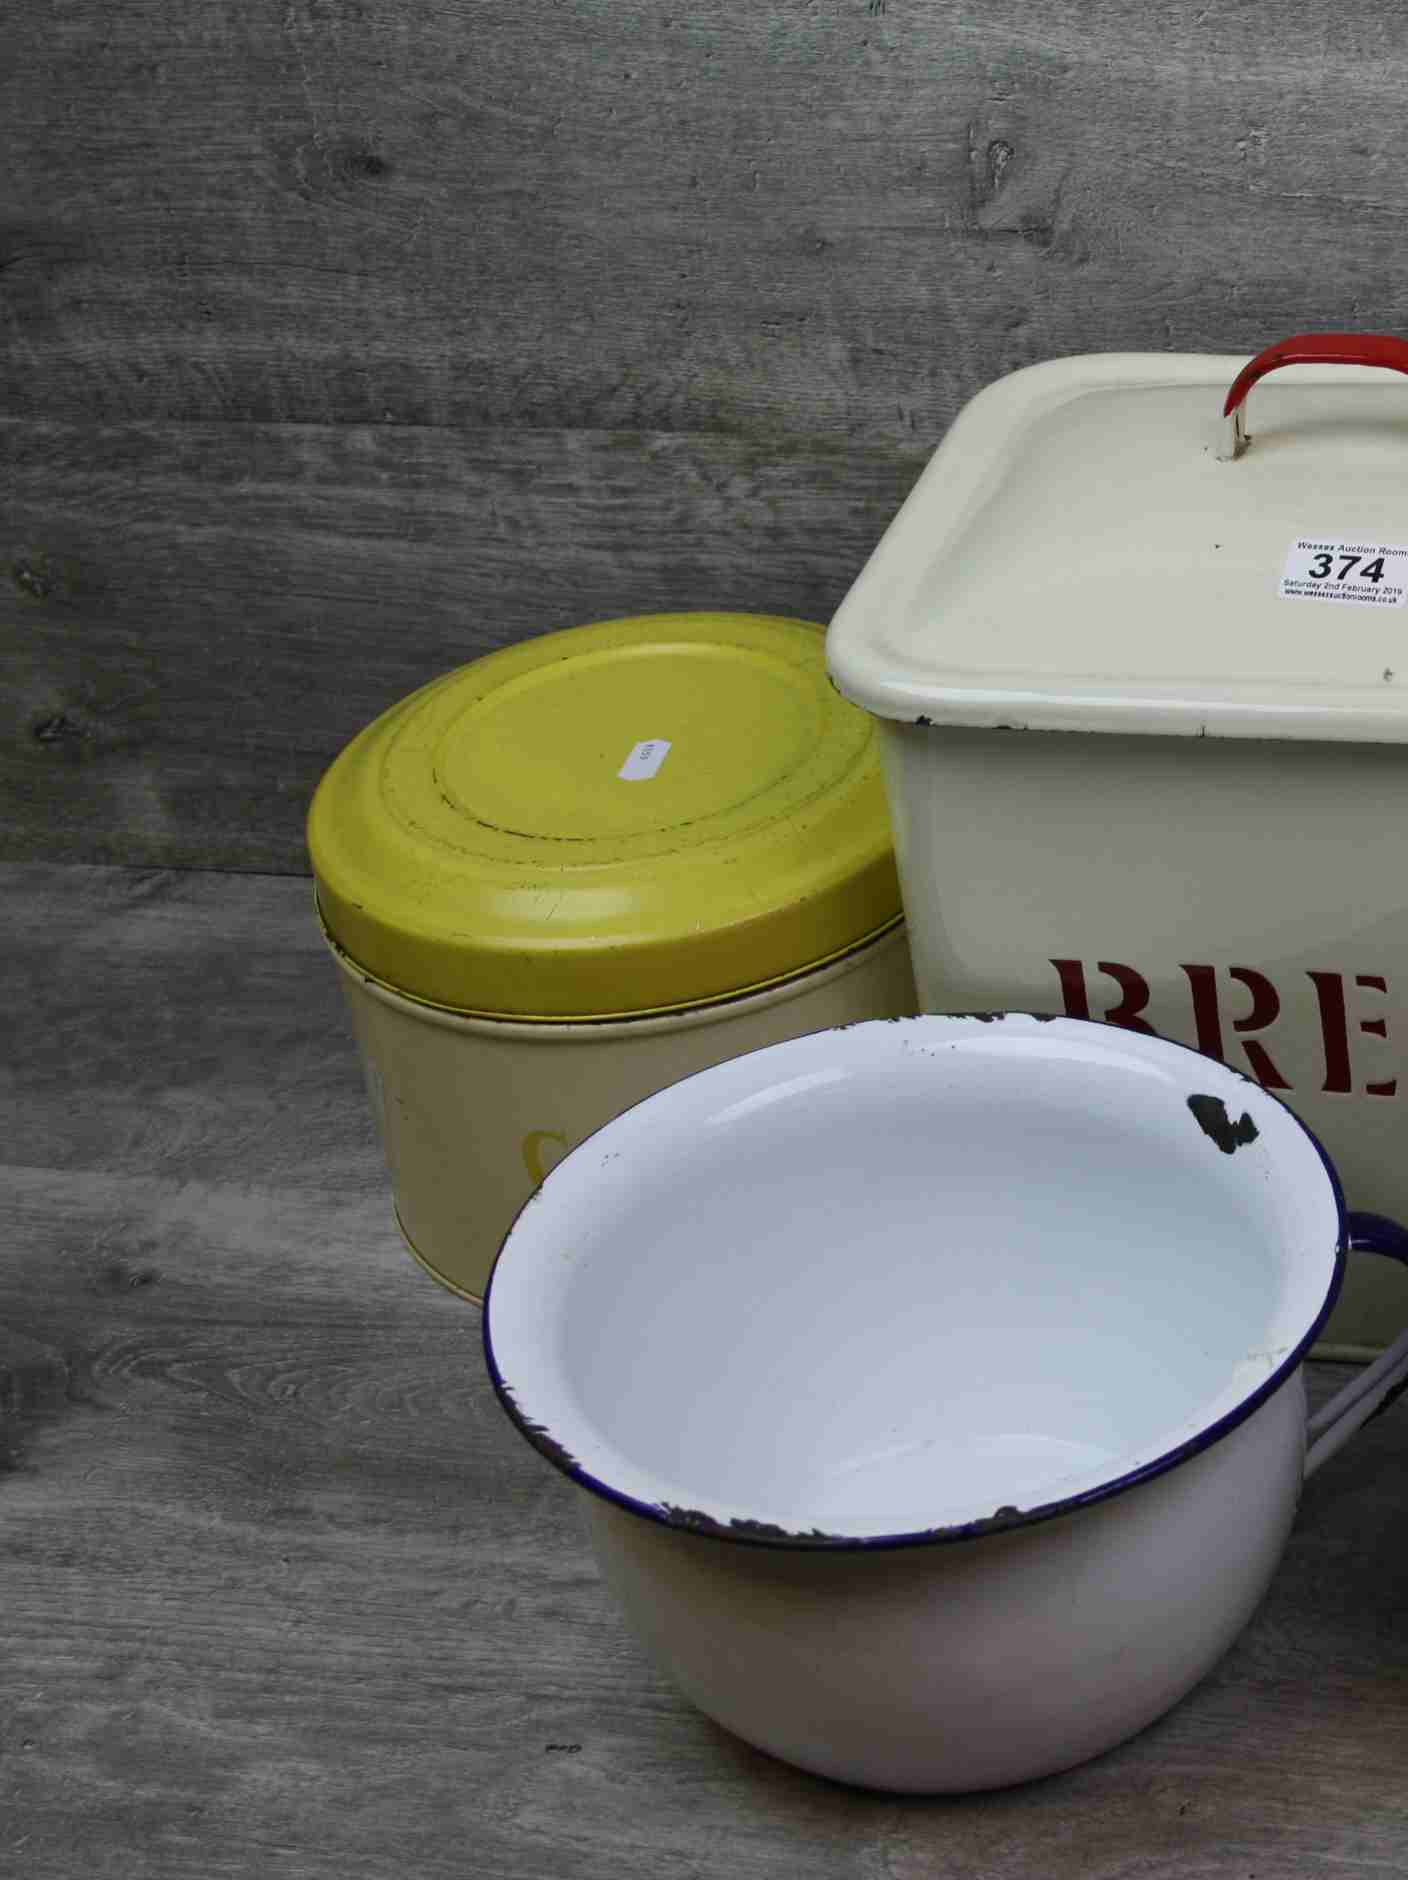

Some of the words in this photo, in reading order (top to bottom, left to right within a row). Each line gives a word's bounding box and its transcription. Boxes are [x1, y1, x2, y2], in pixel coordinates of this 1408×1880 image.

[1297, 541, 1335, 551] Wessex
[1337, 544, 1377, 554] Auction
[1308, 553, 1385, 583] 374
[1284, 578, 1322, 590] Saturday
[1323, 583, 1340, 591] 2nd
[1341, 583, 1381, 595] February
